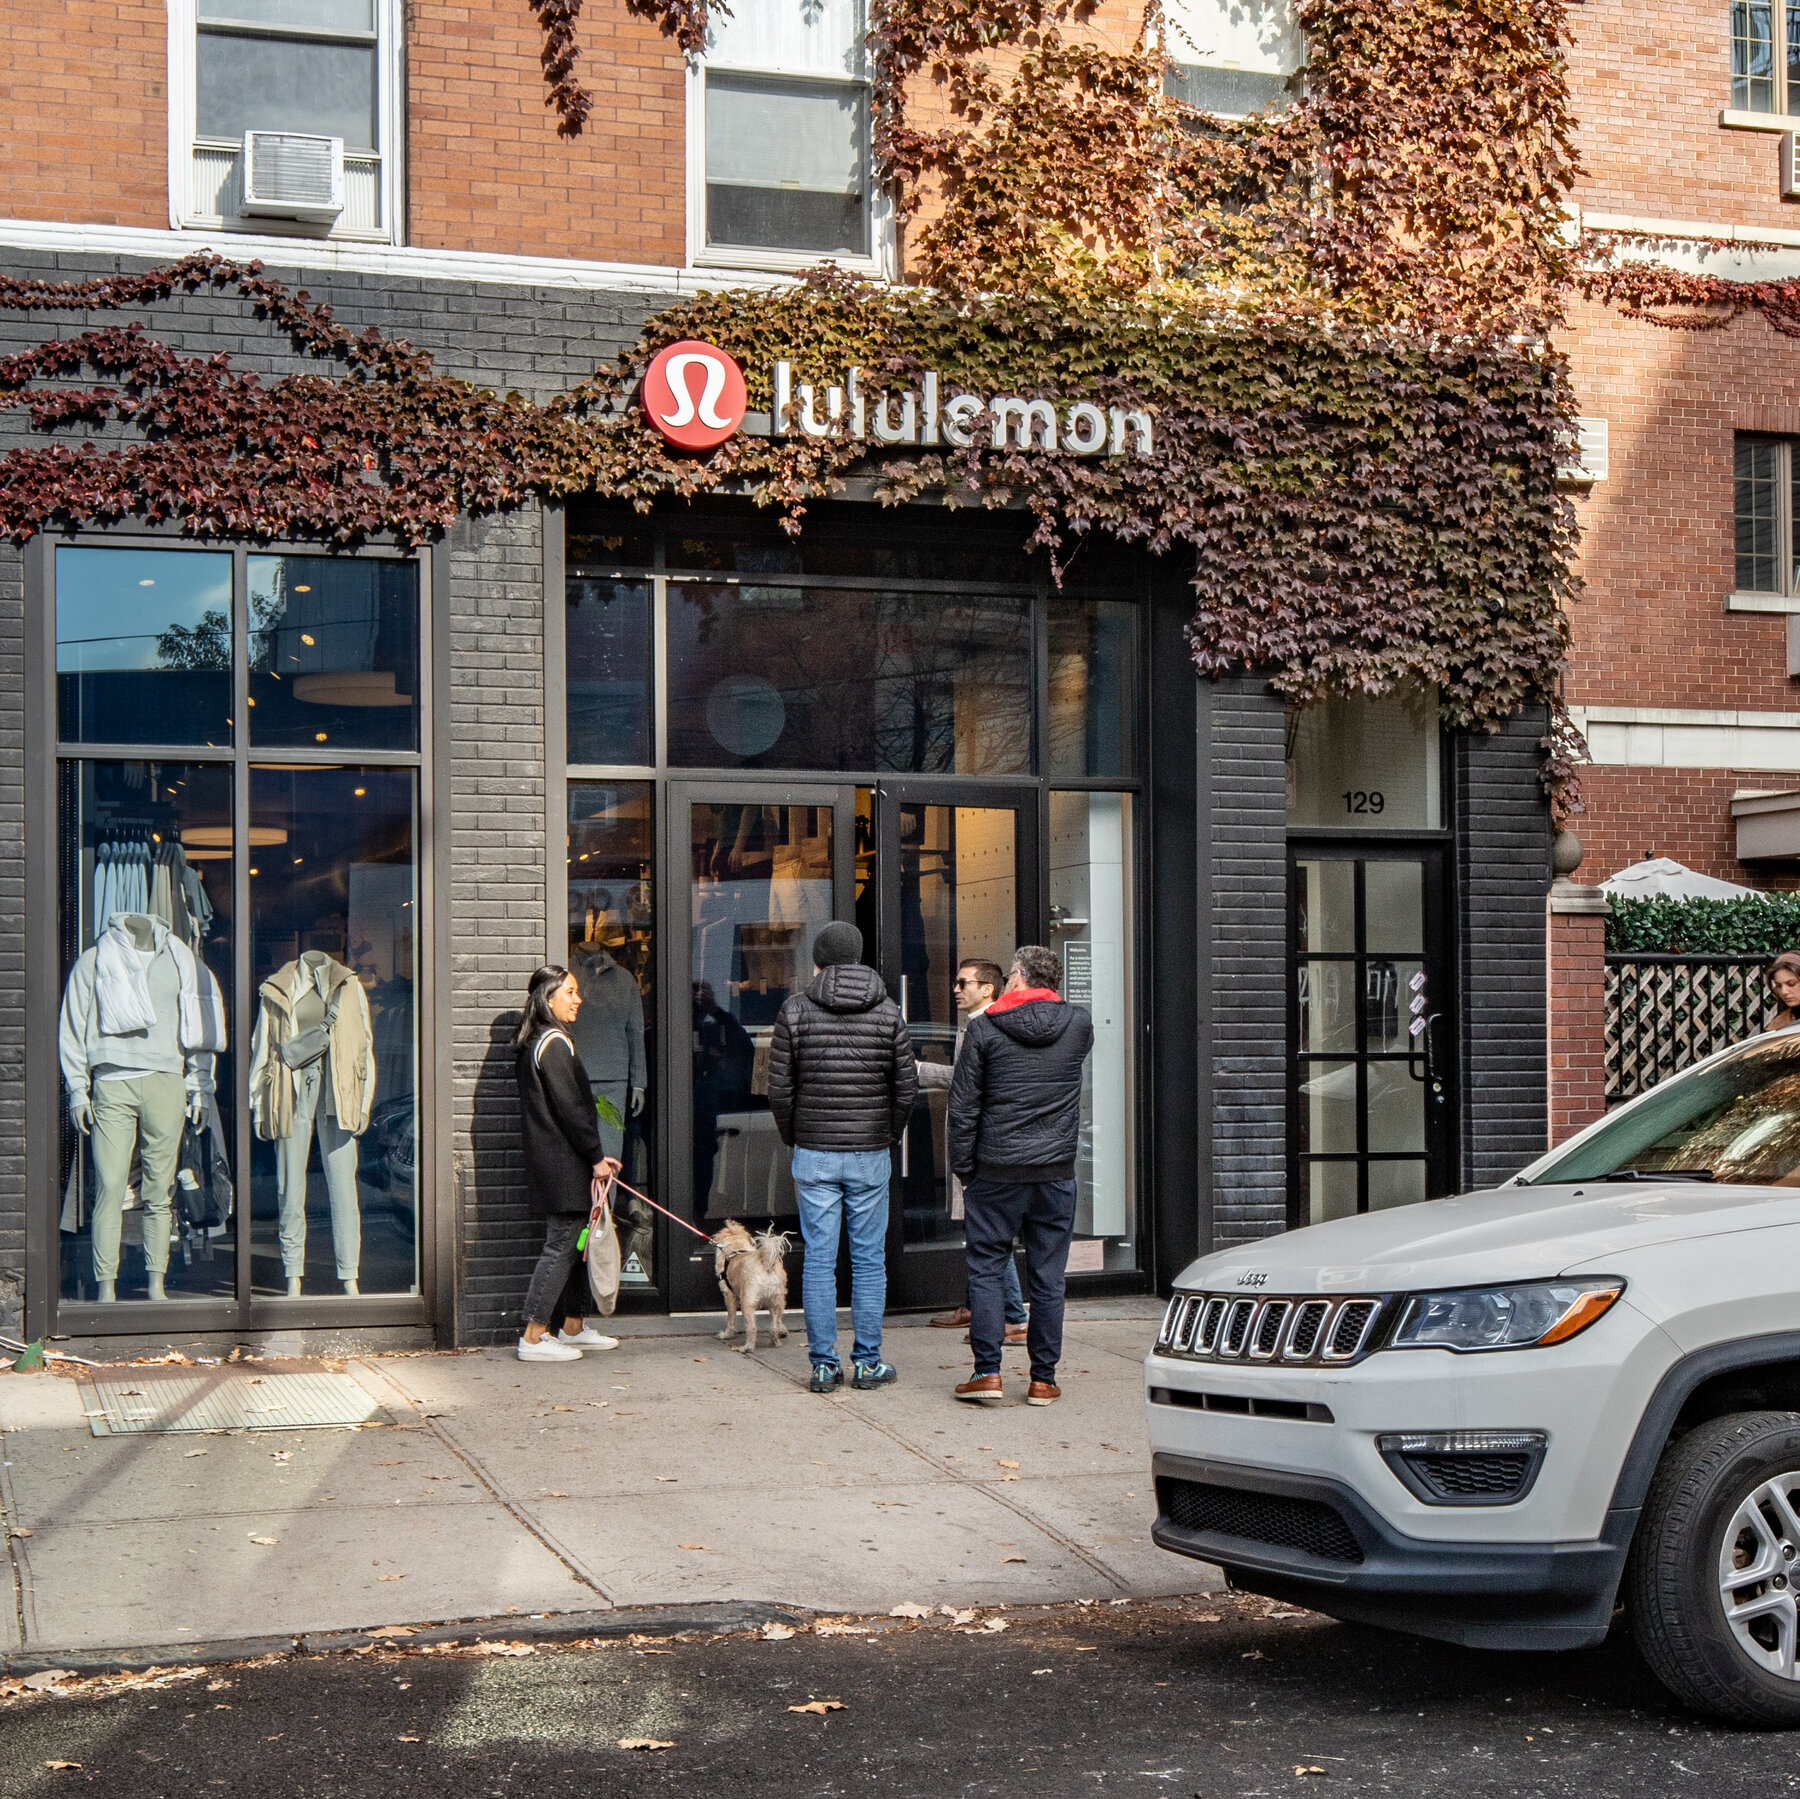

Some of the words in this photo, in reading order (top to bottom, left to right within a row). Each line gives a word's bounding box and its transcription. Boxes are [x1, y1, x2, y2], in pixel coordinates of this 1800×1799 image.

[774, 361, 1153, 457] lululemon
[1342, 791, 1384, 814] 129
[1237, 1269, 1269, 1289] Jeep
